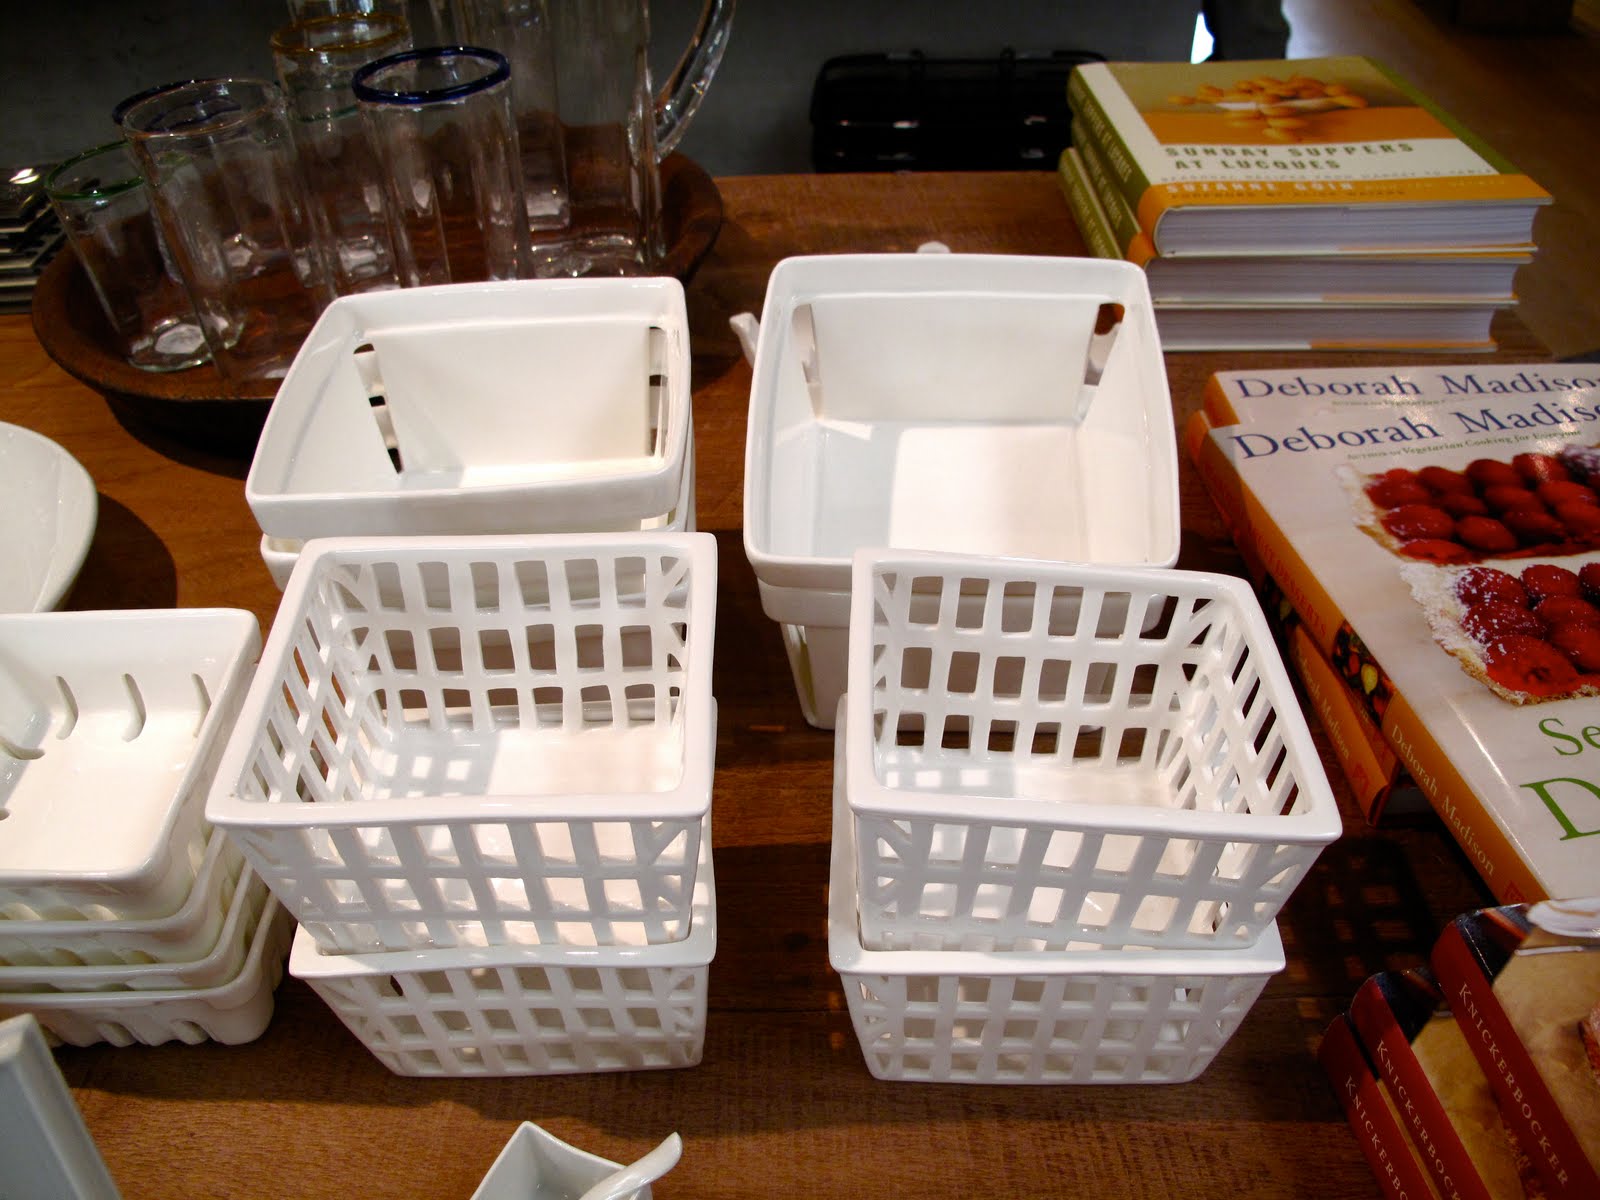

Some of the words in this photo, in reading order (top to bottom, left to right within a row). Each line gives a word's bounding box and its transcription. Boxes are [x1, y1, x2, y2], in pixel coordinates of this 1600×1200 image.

[1165, 147, 1269, 157] SUNDAY
[1287, 143, 1414, 157] SUPPERS
[1175, 160, 1202, 170] AT
[1220, 160, 1341, 170] LUCQUES
[1234, 375, 1424, 398] Deborah
[1436, 372, 1600, 398] Madiso
[1228, 416, 1443, 459] Deborah
[1449, 403, 1600, 434] Madis
[1402, 440, 1464, 454] Vegetarian
[1390, 724, 1439, 797] Deborah
[1441, 796, 1496, 876] Madison
[1458, 983, 1570, 1187] KNICKERBOCKER
